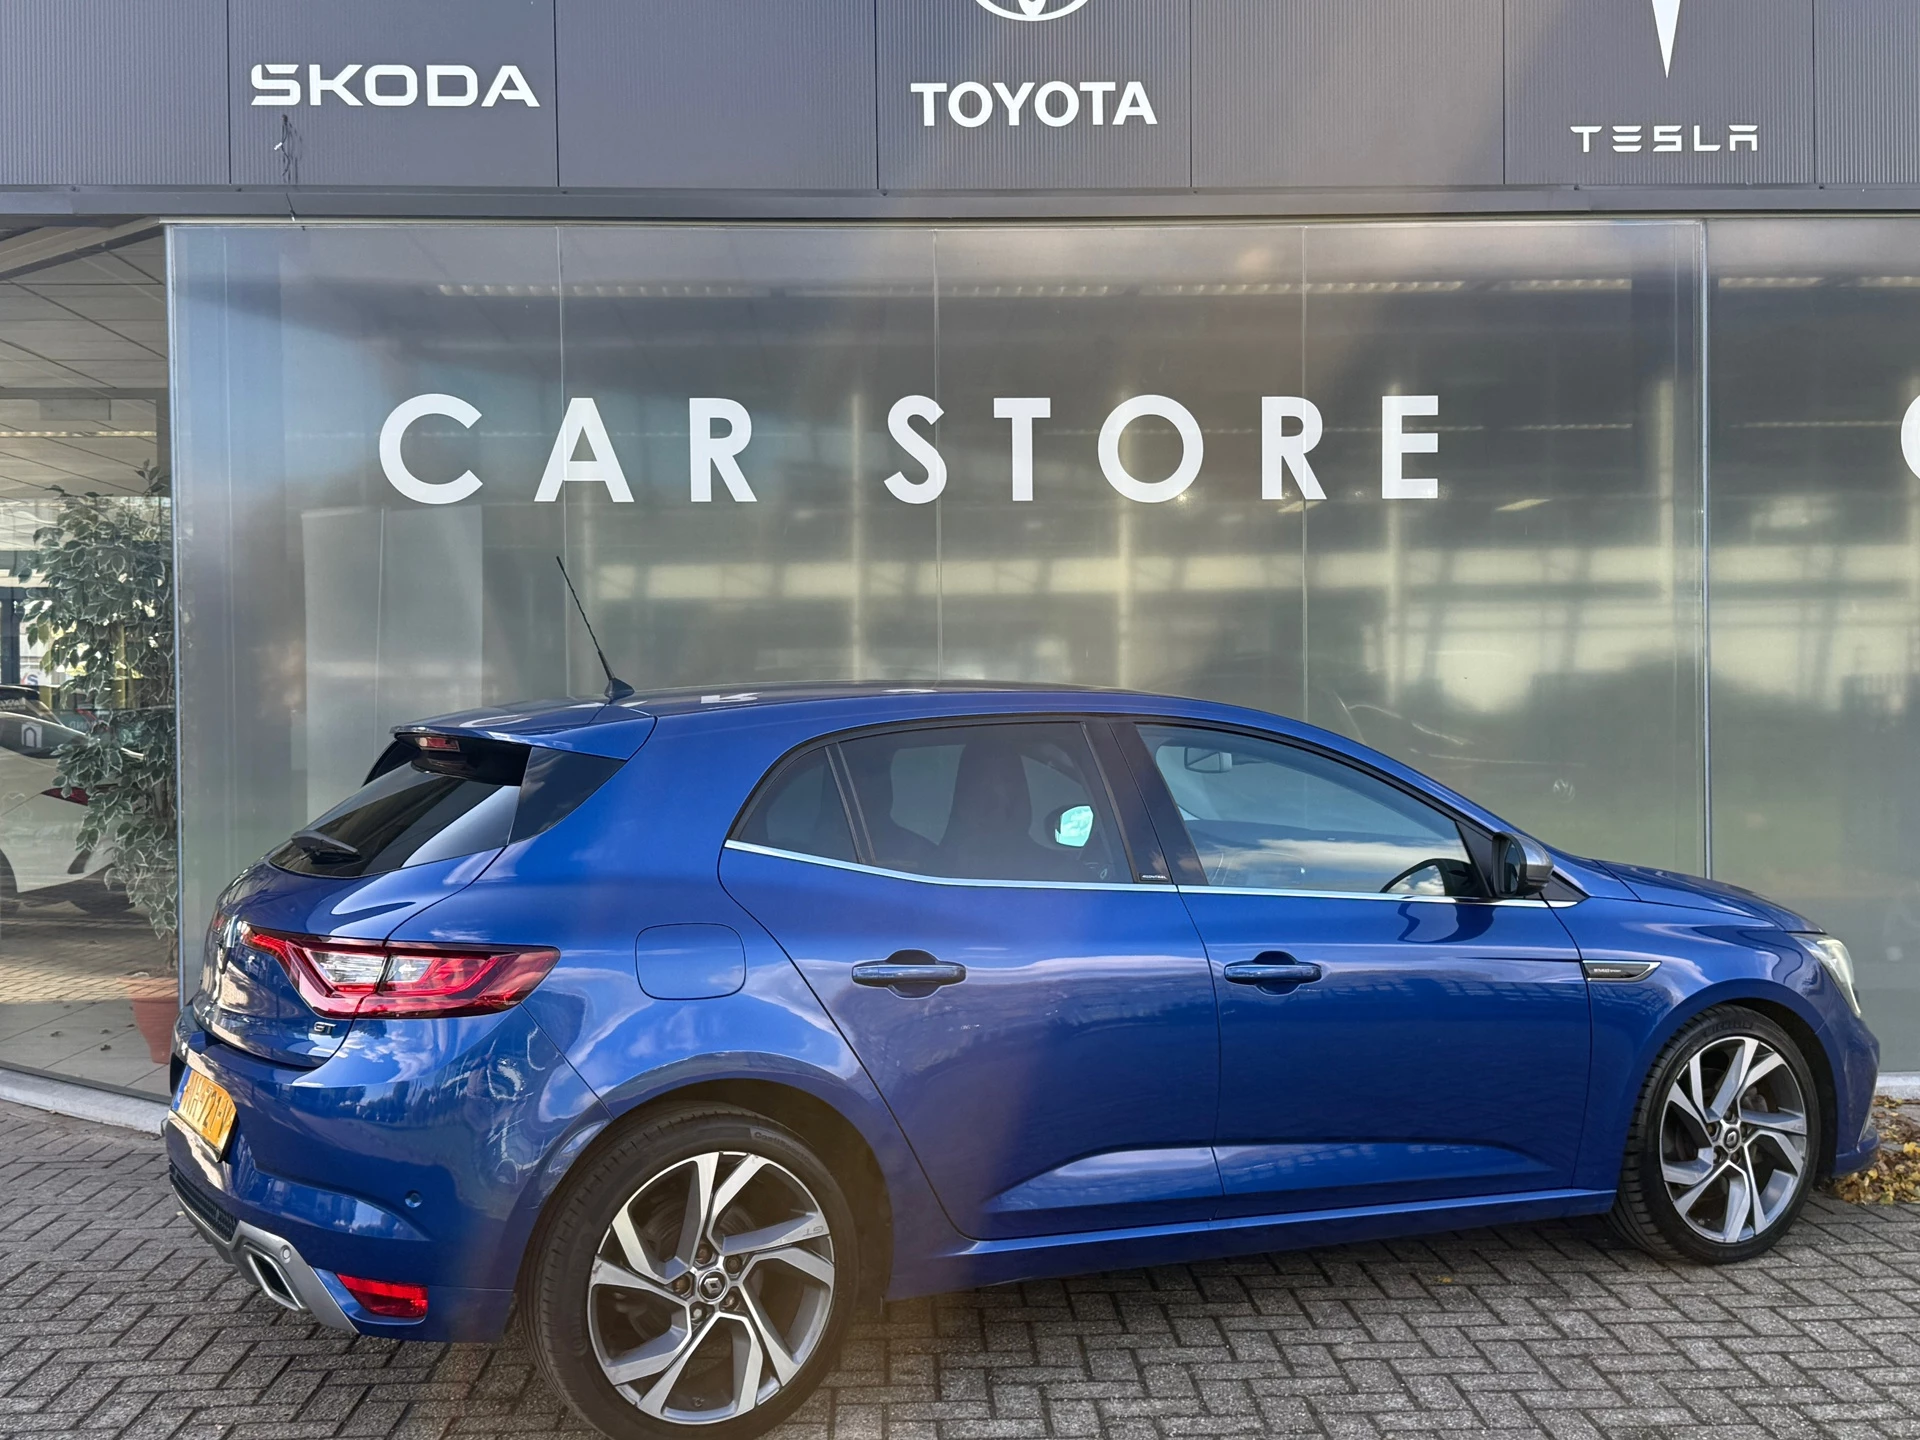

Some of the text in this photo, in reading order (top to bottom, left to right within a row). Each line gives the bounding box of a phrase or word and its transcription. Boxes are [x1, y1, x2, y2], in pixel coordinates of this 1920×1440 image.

[910, 80, 1158, 128] TOYOTA
[1570, 124, 1759, 154] TESLA
[379, 393, 1440, 505] CAR STORE
[314, 1021, 337, 1034] GT
